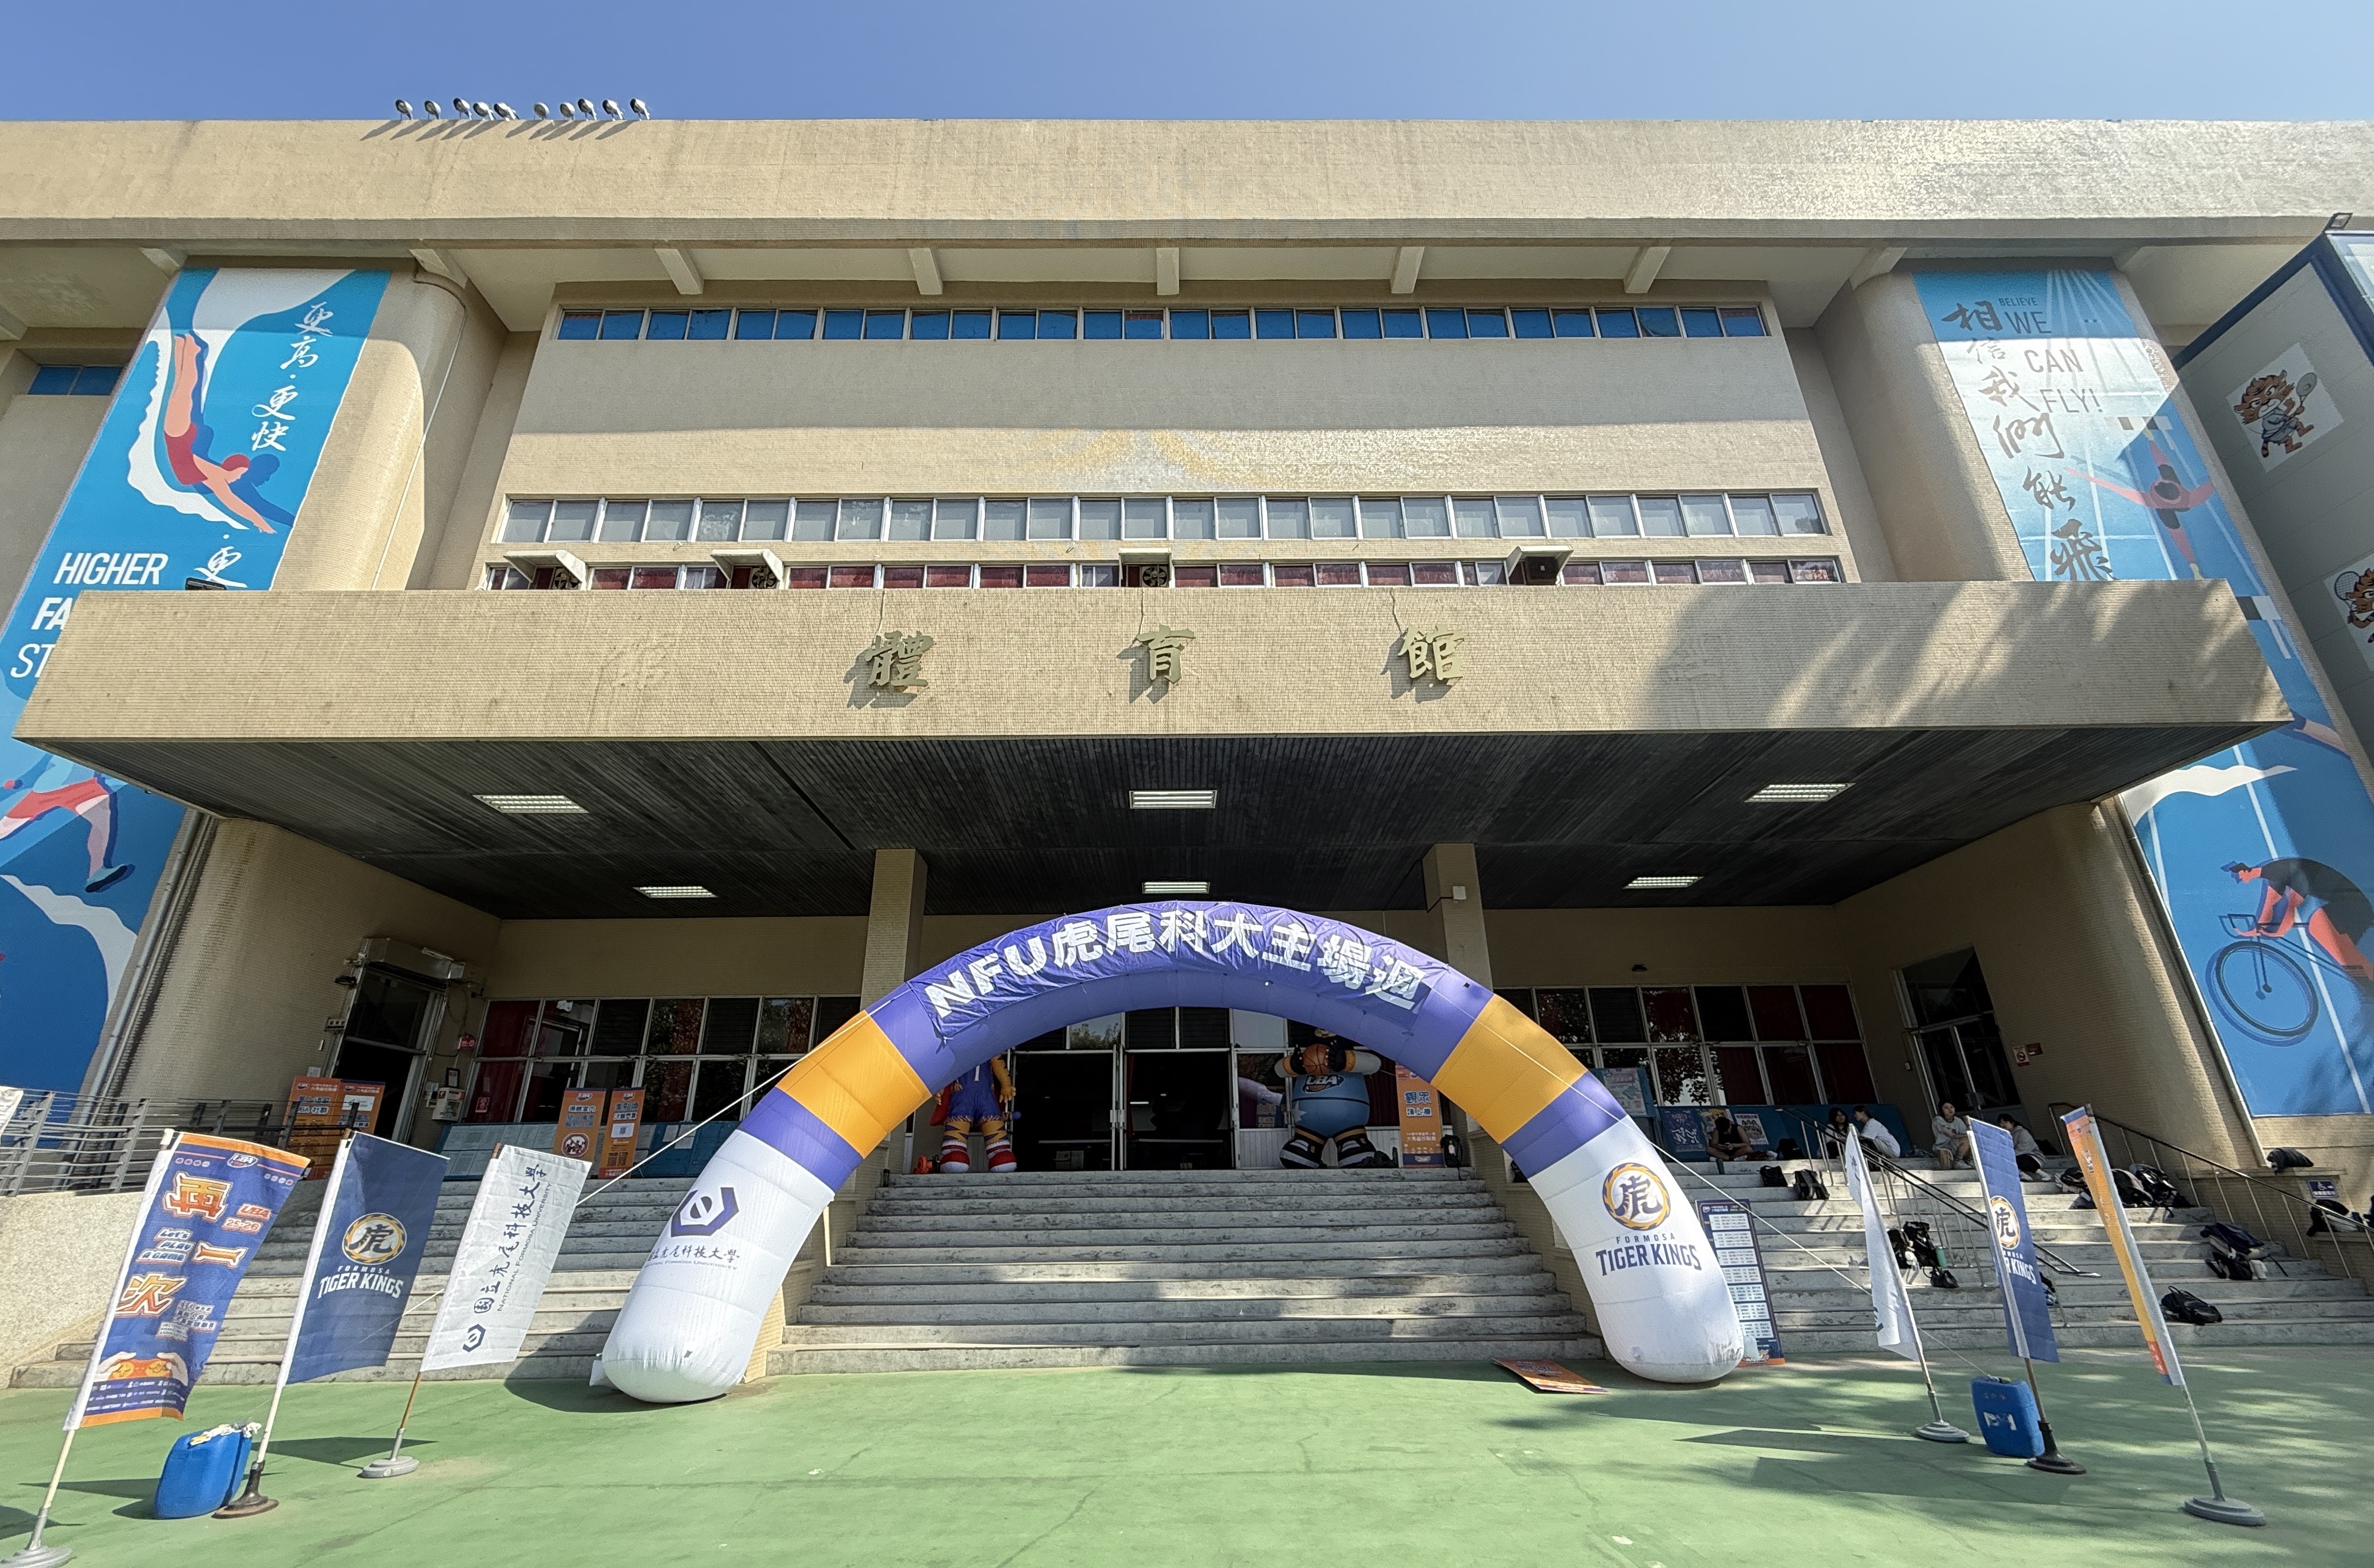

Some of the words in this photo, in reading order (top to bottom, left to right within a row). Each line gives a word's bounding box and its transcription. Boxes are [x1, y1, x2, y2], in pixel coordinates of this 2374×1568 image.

[1998, 297, 2038, 306] BELIEVE
[2004, 311, 2051, 334] WE
[2024, 349, 2083, 373] CAN
[2040, 388, 2103, 413] FLY!
[54, 552, 168, 585] HIGHER
[866, 624, 1465, 688] 體育館
[1615, 1175, 1663, 1220] 虎
[240, 1205, 270, 1218] UBA
[1995, 1206, 2016, 1238] 虎
[226, 1218, 261, 1231] 25-26
[160, 1241, 192, 1251] PLAY
[349, 1224, 394, 1254] 虎
[497, 1269, 519, 1311] NATIONAL
[515, 1228, 535, 1267] FORMOSA
[533, 1182, 552, 1226] UNIVERSITY
[1616, 1232, 1676, 1244] FORMOSA
[1595, 1244, 1650, 1277] TIGER
[1650, 1243, 1702, 1271] KINGS
[2003, 1251, 2023, 1259] RMOSA
[337, 1265, 390, 1275] FORMOSA
[2011, 1258, 2037, 1285] KINGS
[317, 1272, 360, 1299] TIGER
[359, 1272, 404, 1299] KINGS
